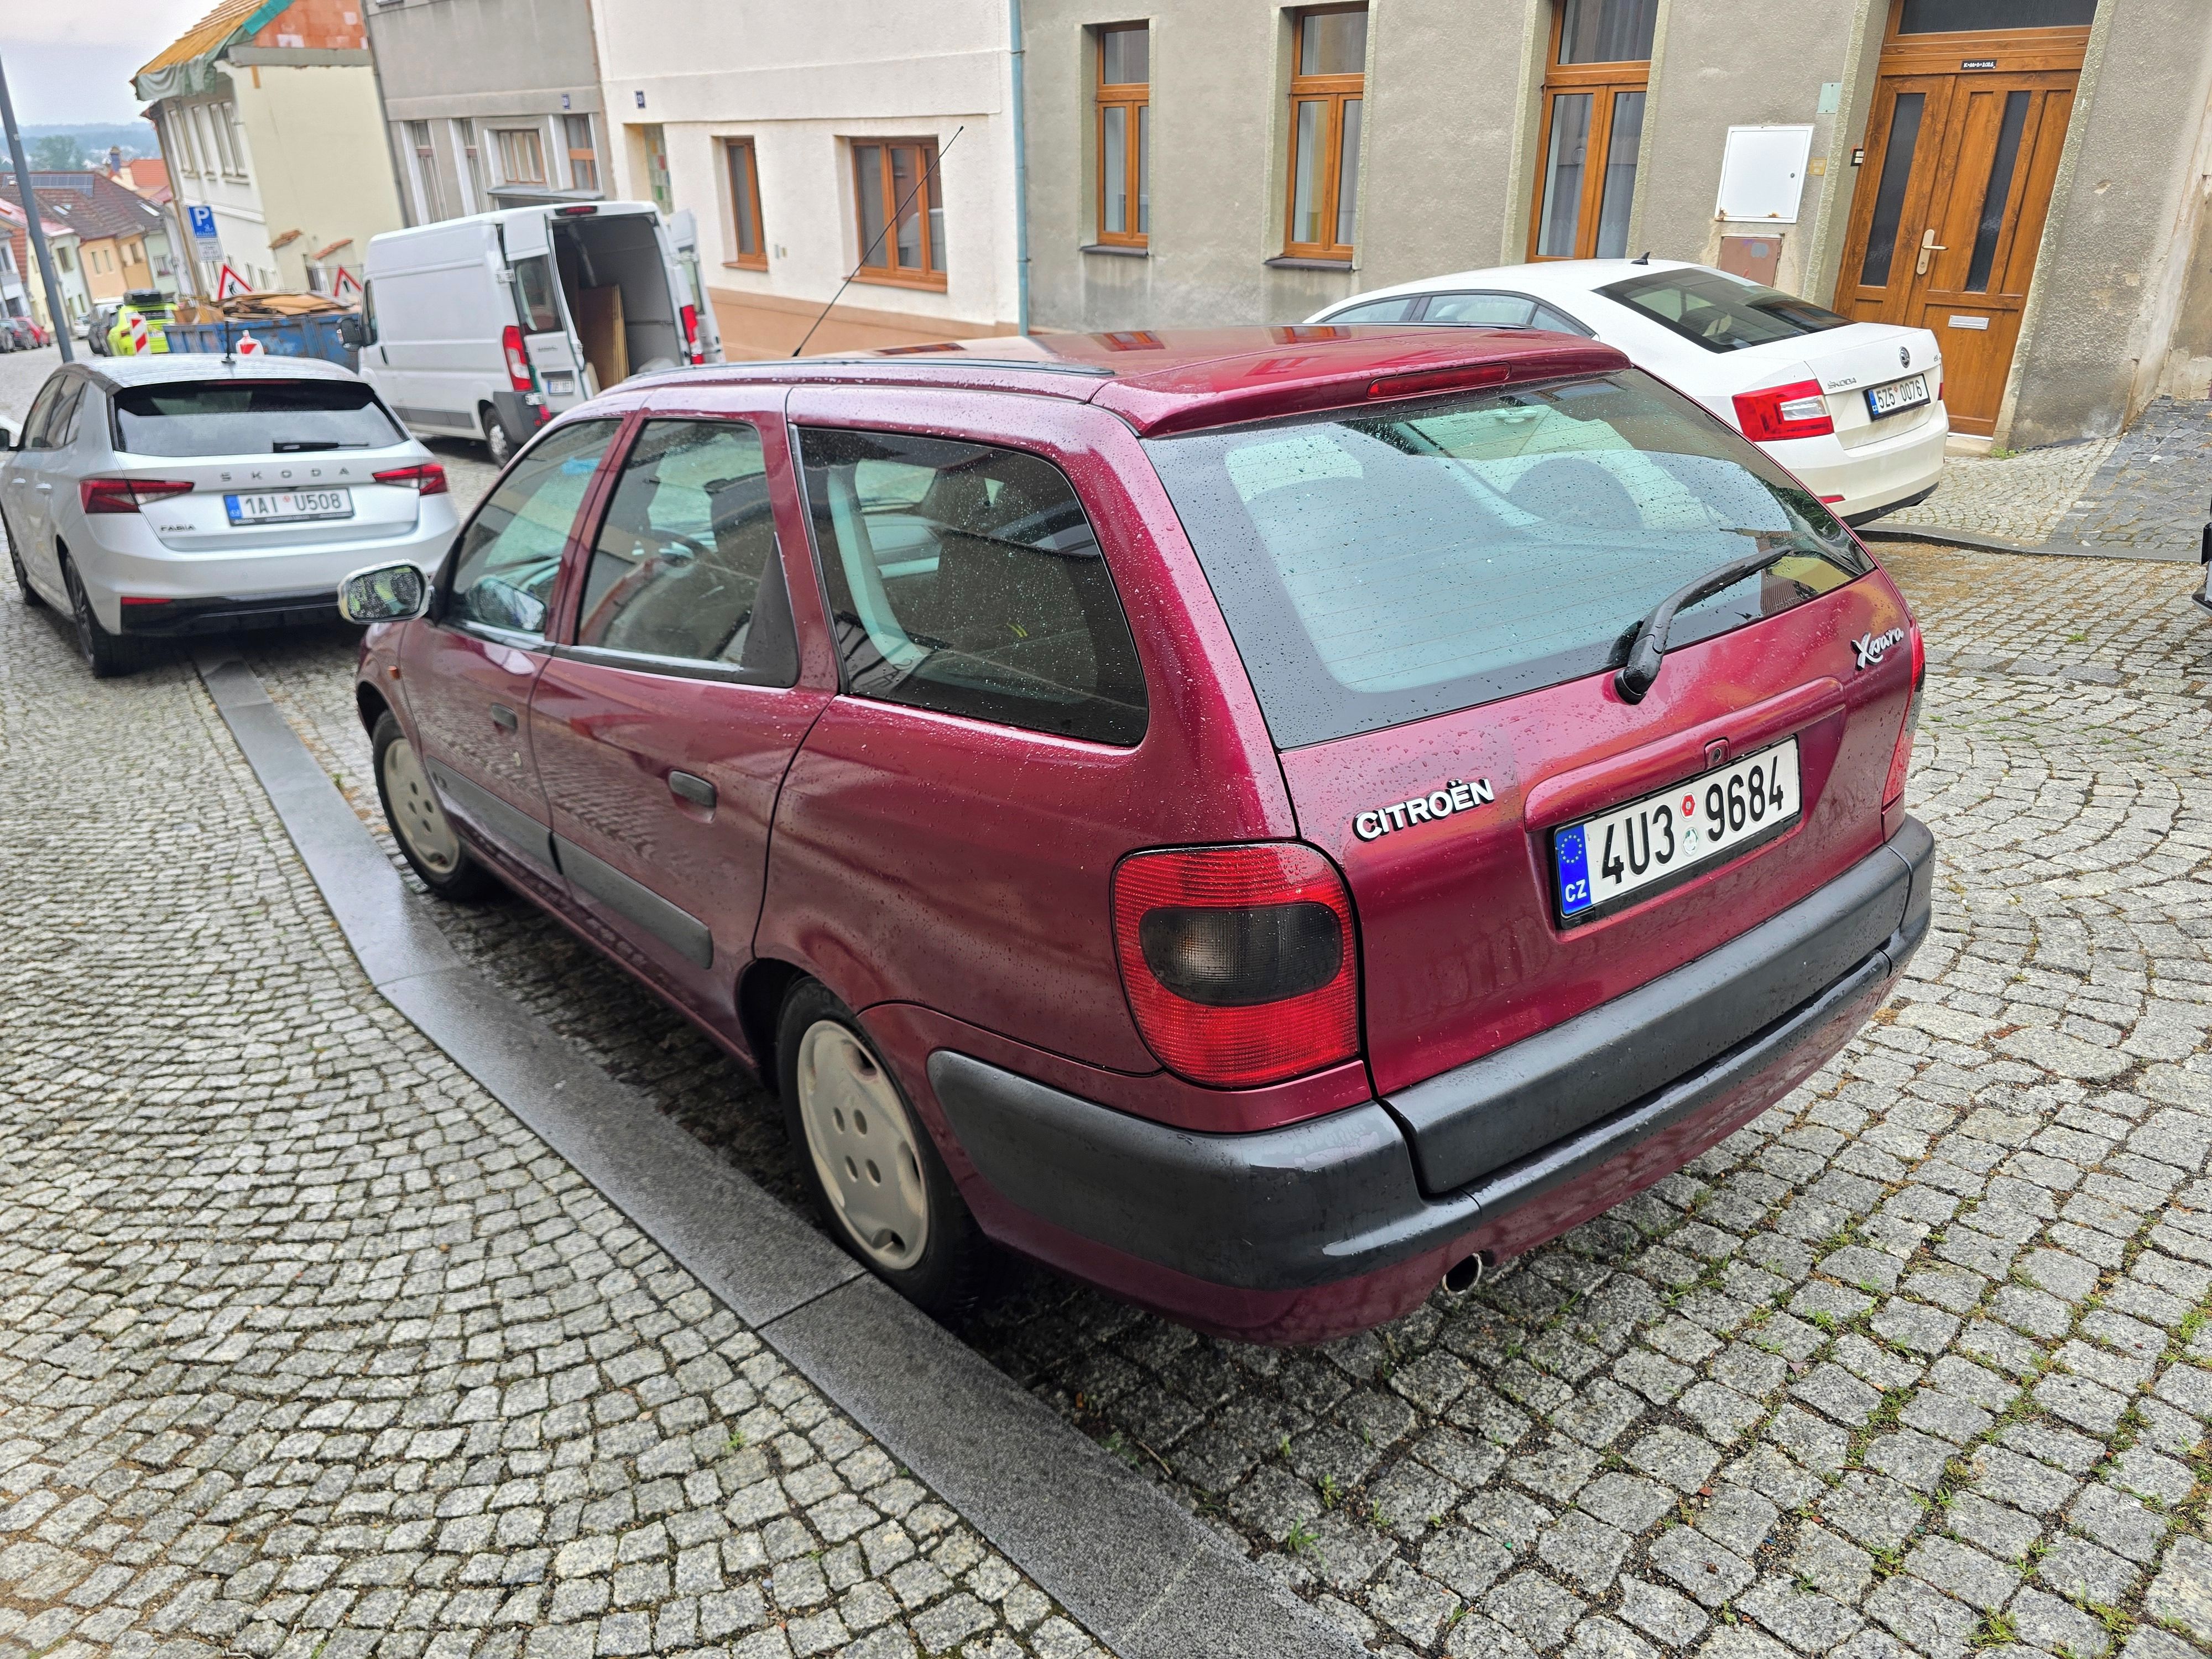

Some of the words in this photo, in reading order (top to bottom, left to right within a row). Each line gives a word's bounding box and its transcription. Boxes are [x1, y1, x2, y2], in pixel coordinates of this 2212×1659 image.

[193, 207, 210, 226] P
[1876, 388, 1896, 409] 5Z5
[1900, 379, 1922, 401] 0076
[246, 497, 278, 515] 1AI
[294, 493, 341, 511] U508
[160, 524, 196, 532] FABIA
[1851, 627, 1904, 670] Xsara
[1353, 778, 1495, 842] CITROËN
[1602, 804, 1675, 884] 4U3
[1705, 755, 1784, 841] 9684
[1565, 879, 1587, 902] CZ
